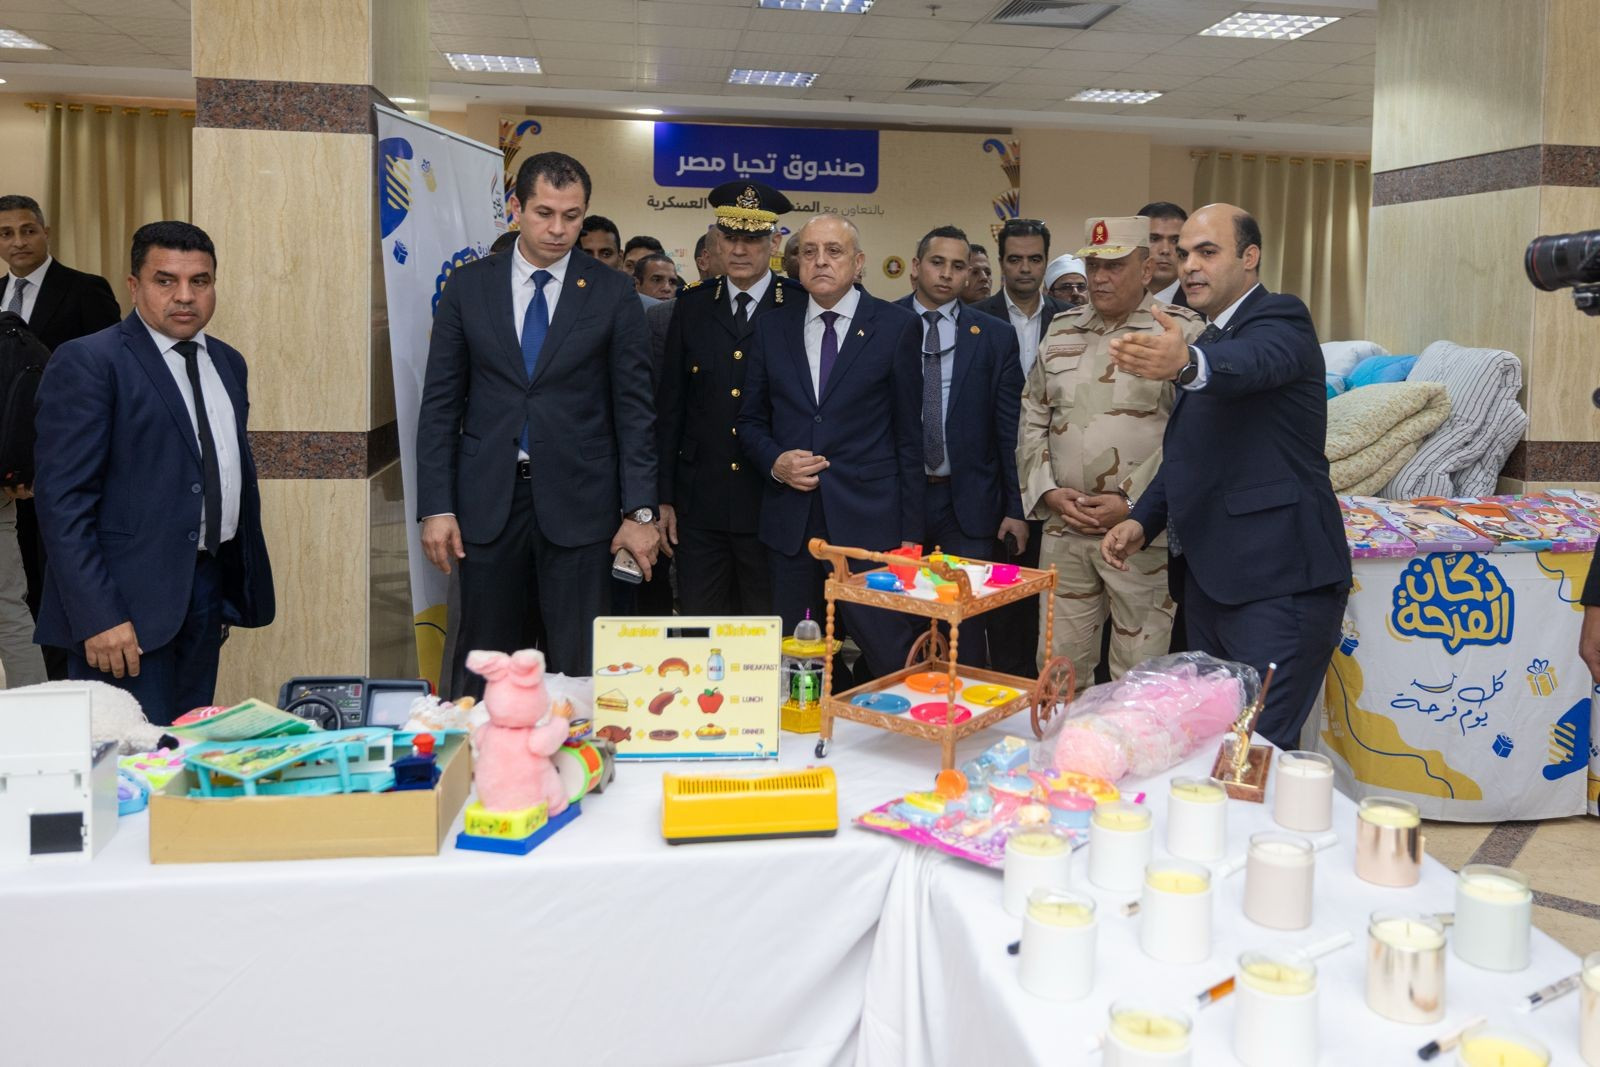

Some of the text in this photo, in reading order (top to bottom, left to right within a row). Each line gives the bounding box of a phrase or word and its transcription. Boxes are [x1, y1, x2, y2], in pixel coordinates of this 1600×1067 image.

[675, 152, 865, 182] صندوق تحيا مصر
[647, 195, 708, 211] العسكرية
[822, 204, 838, 215] مع
[840, 203, 885, 217] بالتعاون
[617, 623, 768, 638] Junior Kitchen
[743, 663, 778, 671] BREAKFAST
[1457, 669, 1507, 709] كل
[1390, 692, 1489, 737] يوم فرحة
